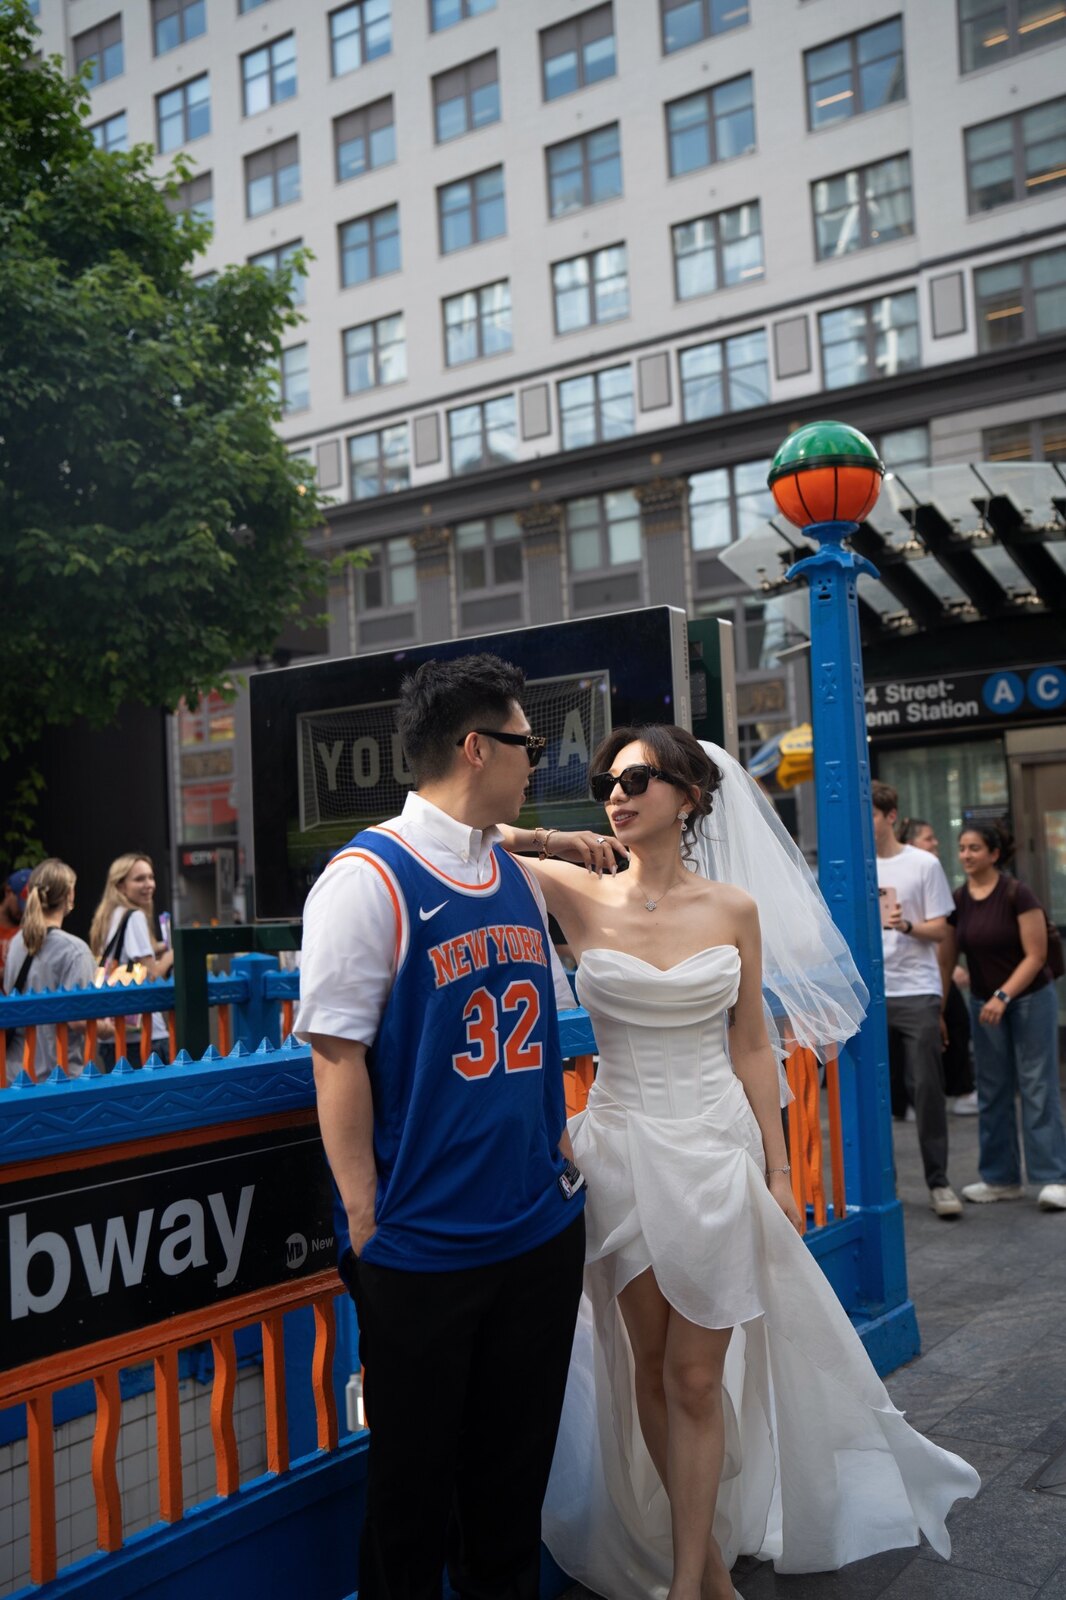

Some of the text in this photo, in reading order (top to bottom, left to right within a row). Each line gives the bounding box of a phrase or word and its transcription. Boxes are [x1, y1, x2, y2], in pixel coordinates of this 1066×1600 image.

[885, 680, 955, 704] Street-
[993, 678, 1015, 704] A
[1036, 674, 1060, 700] C
[907, 699, 978, 723] Station
[427, 924, 547, 989] NEW YORK
[452, 979, 543, 1081] 32
[9, 1184, 256, 1321] bway
[311, 1236, 334, 1253] New
